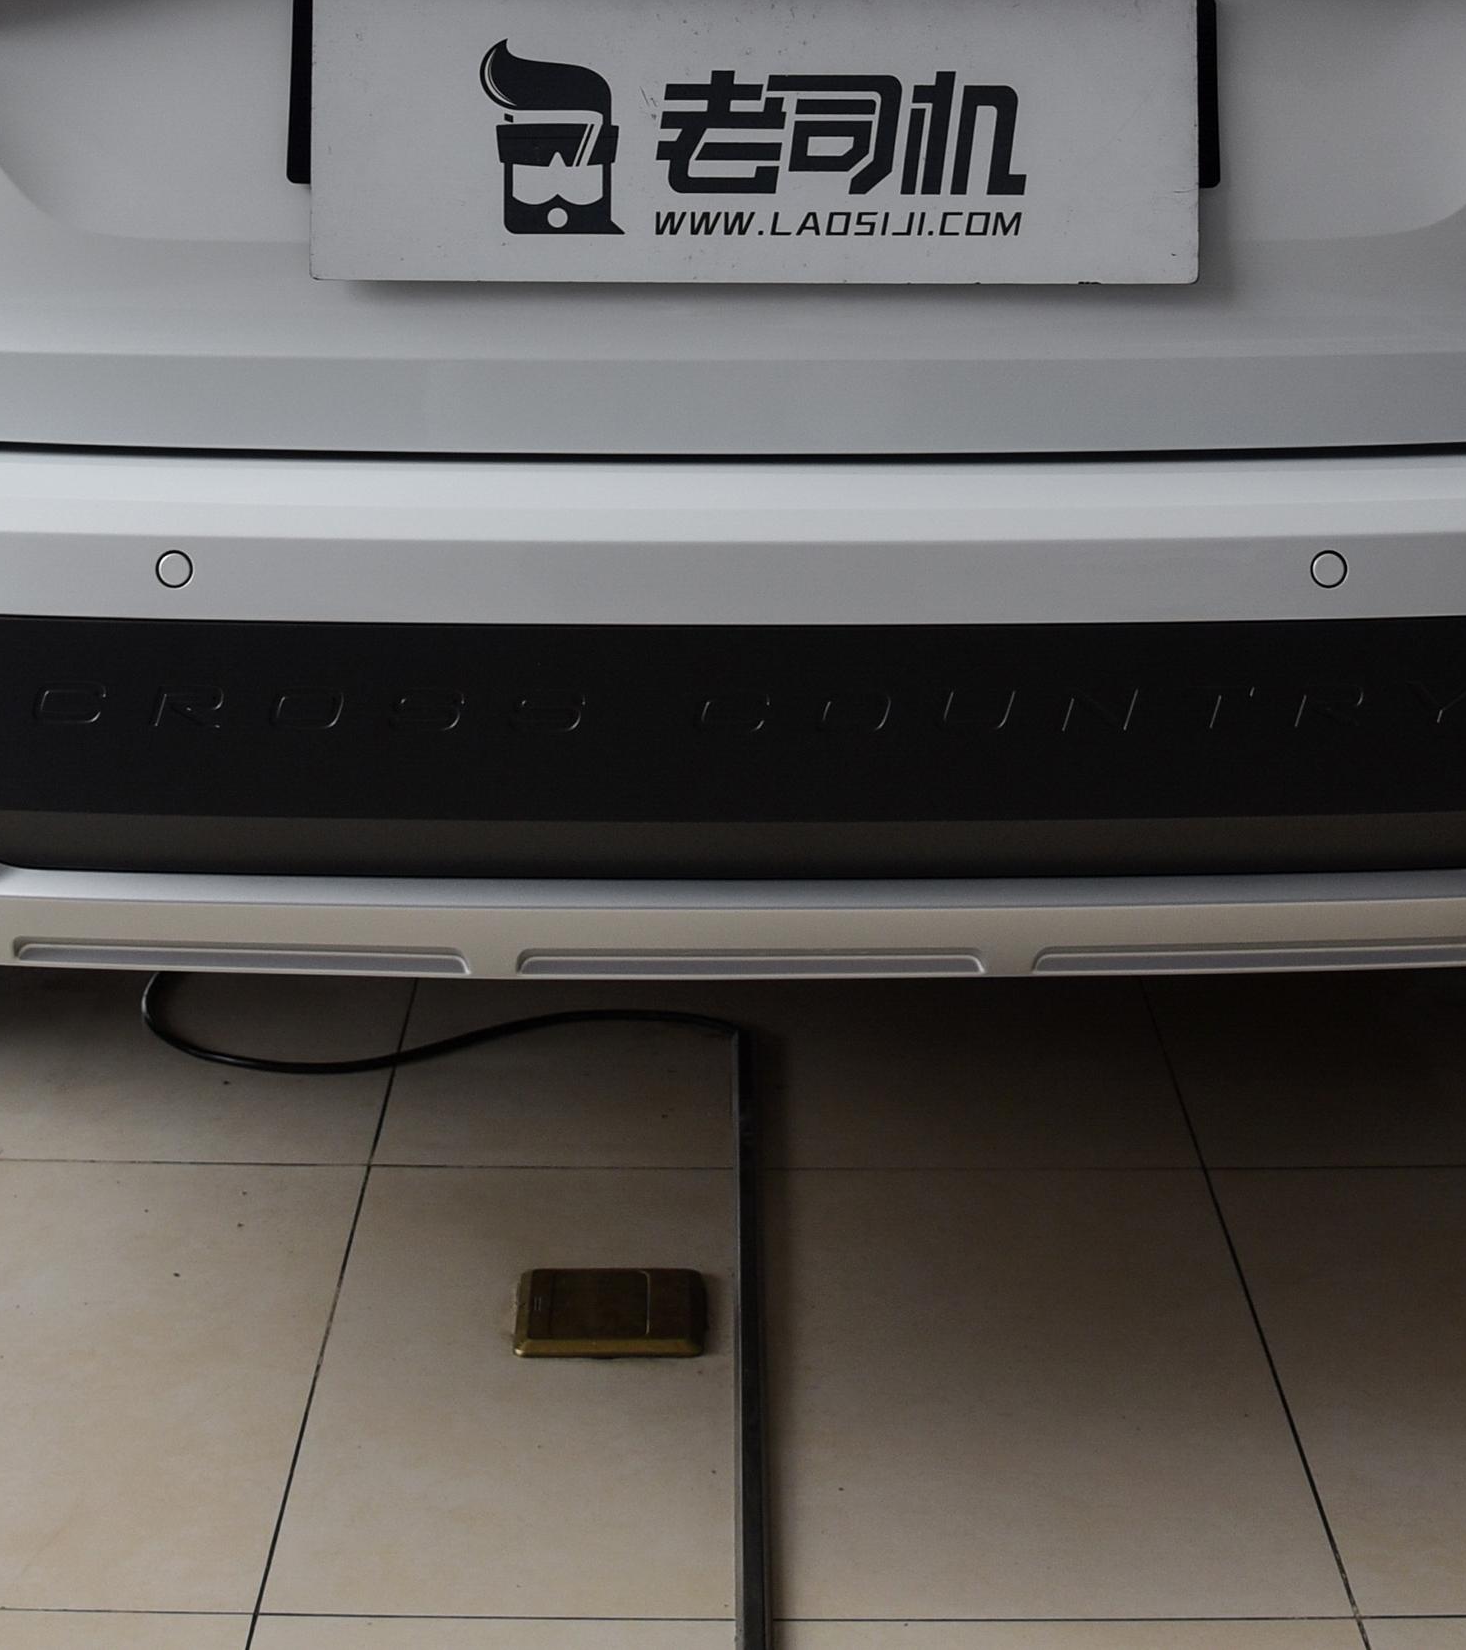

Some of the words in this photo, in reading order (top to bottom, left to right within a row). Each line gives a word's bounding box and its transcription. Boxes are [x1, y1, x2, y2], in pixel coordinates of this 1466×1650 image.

[655, 69, 1028, 196] 老司机
[654, 210, 1023, 238] WWW.LAOSIJI.COM
[33, 679, 587, 733] CROSS
